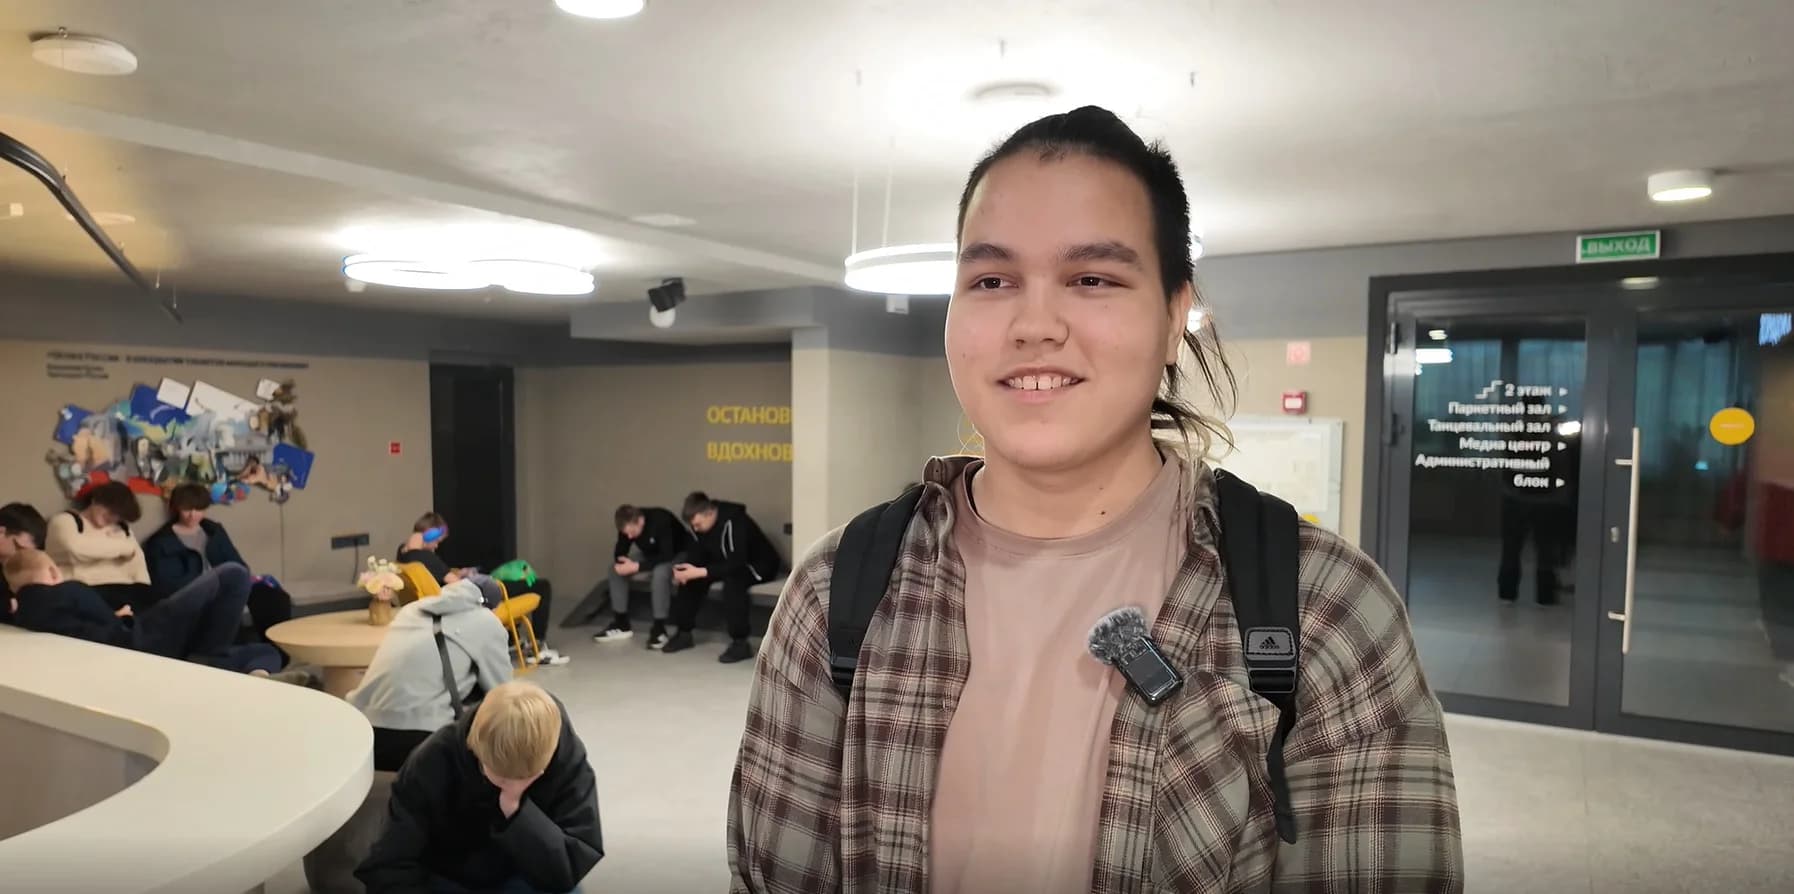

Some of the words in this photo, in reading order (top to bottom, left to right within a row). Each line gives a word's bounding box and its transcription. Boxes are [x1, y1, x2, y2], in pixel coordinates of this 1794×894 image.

[1586, 236, 1651, 256] ВЫХОД
[1505, 383, 1515, 397] 2
[1517, 385, 1552, 397] этаж
[707, 405, 791, 425] ОСТАНОВ
[1448, 401, 1525, 416] Паркетный
[1527, 404, 1552, 415] зал
[1428, 419, 1525, 434] Танцевальный
[1527, 422, 1551, 433] зал
[707, 441, 792, 463] ВДОХНОВ
[1459, 437, 1507, 452] Медиа
[1508, 440, 1551, 453] центр
[1415, 454, 1550, 470] Административный
[1513, 473, 1549, 488] блок
